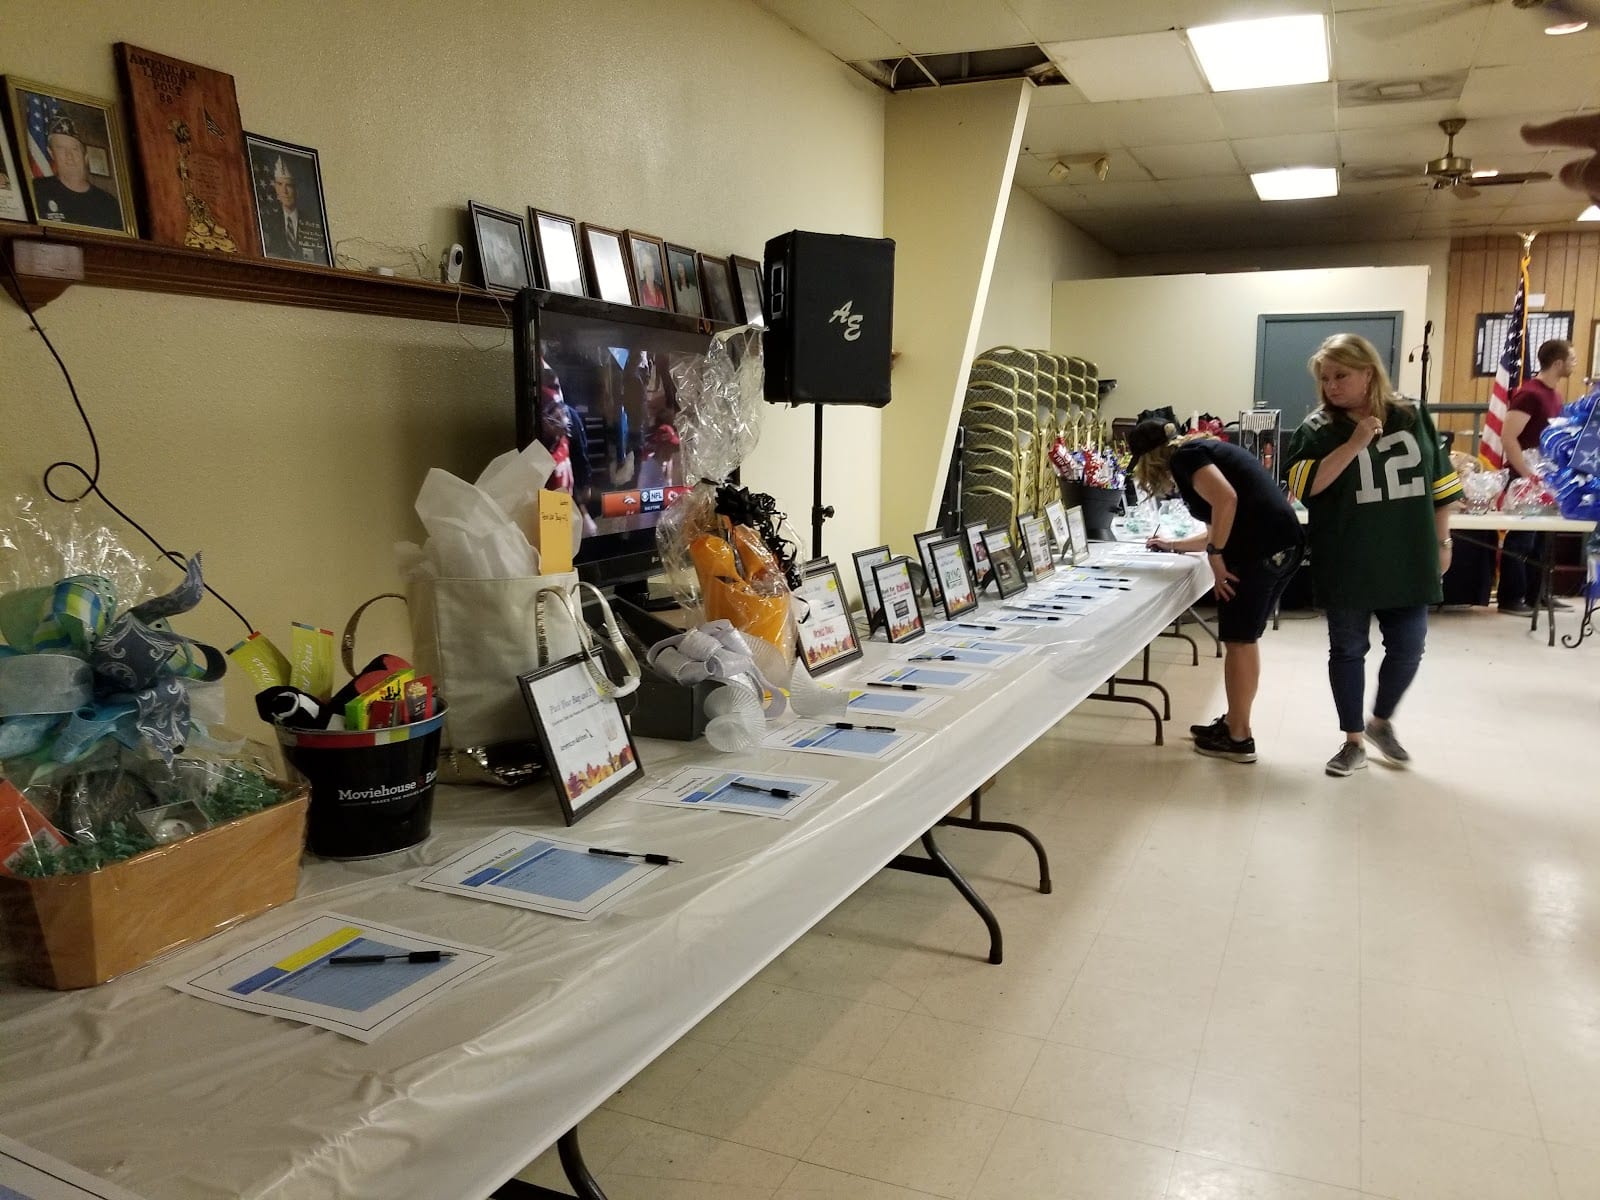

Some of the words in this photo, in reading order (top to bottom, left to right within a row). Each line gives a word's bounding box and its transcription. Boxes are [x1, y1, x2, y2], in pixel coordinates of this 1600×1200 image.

[129, 53, 196, 80] AMERICAN
[143, 65, 187, 86] LEGION
[152, 79, 182, 97] POST
[1355, 430, 1426, 504] 12
[339, 784, 417, 801] Moviehouse
